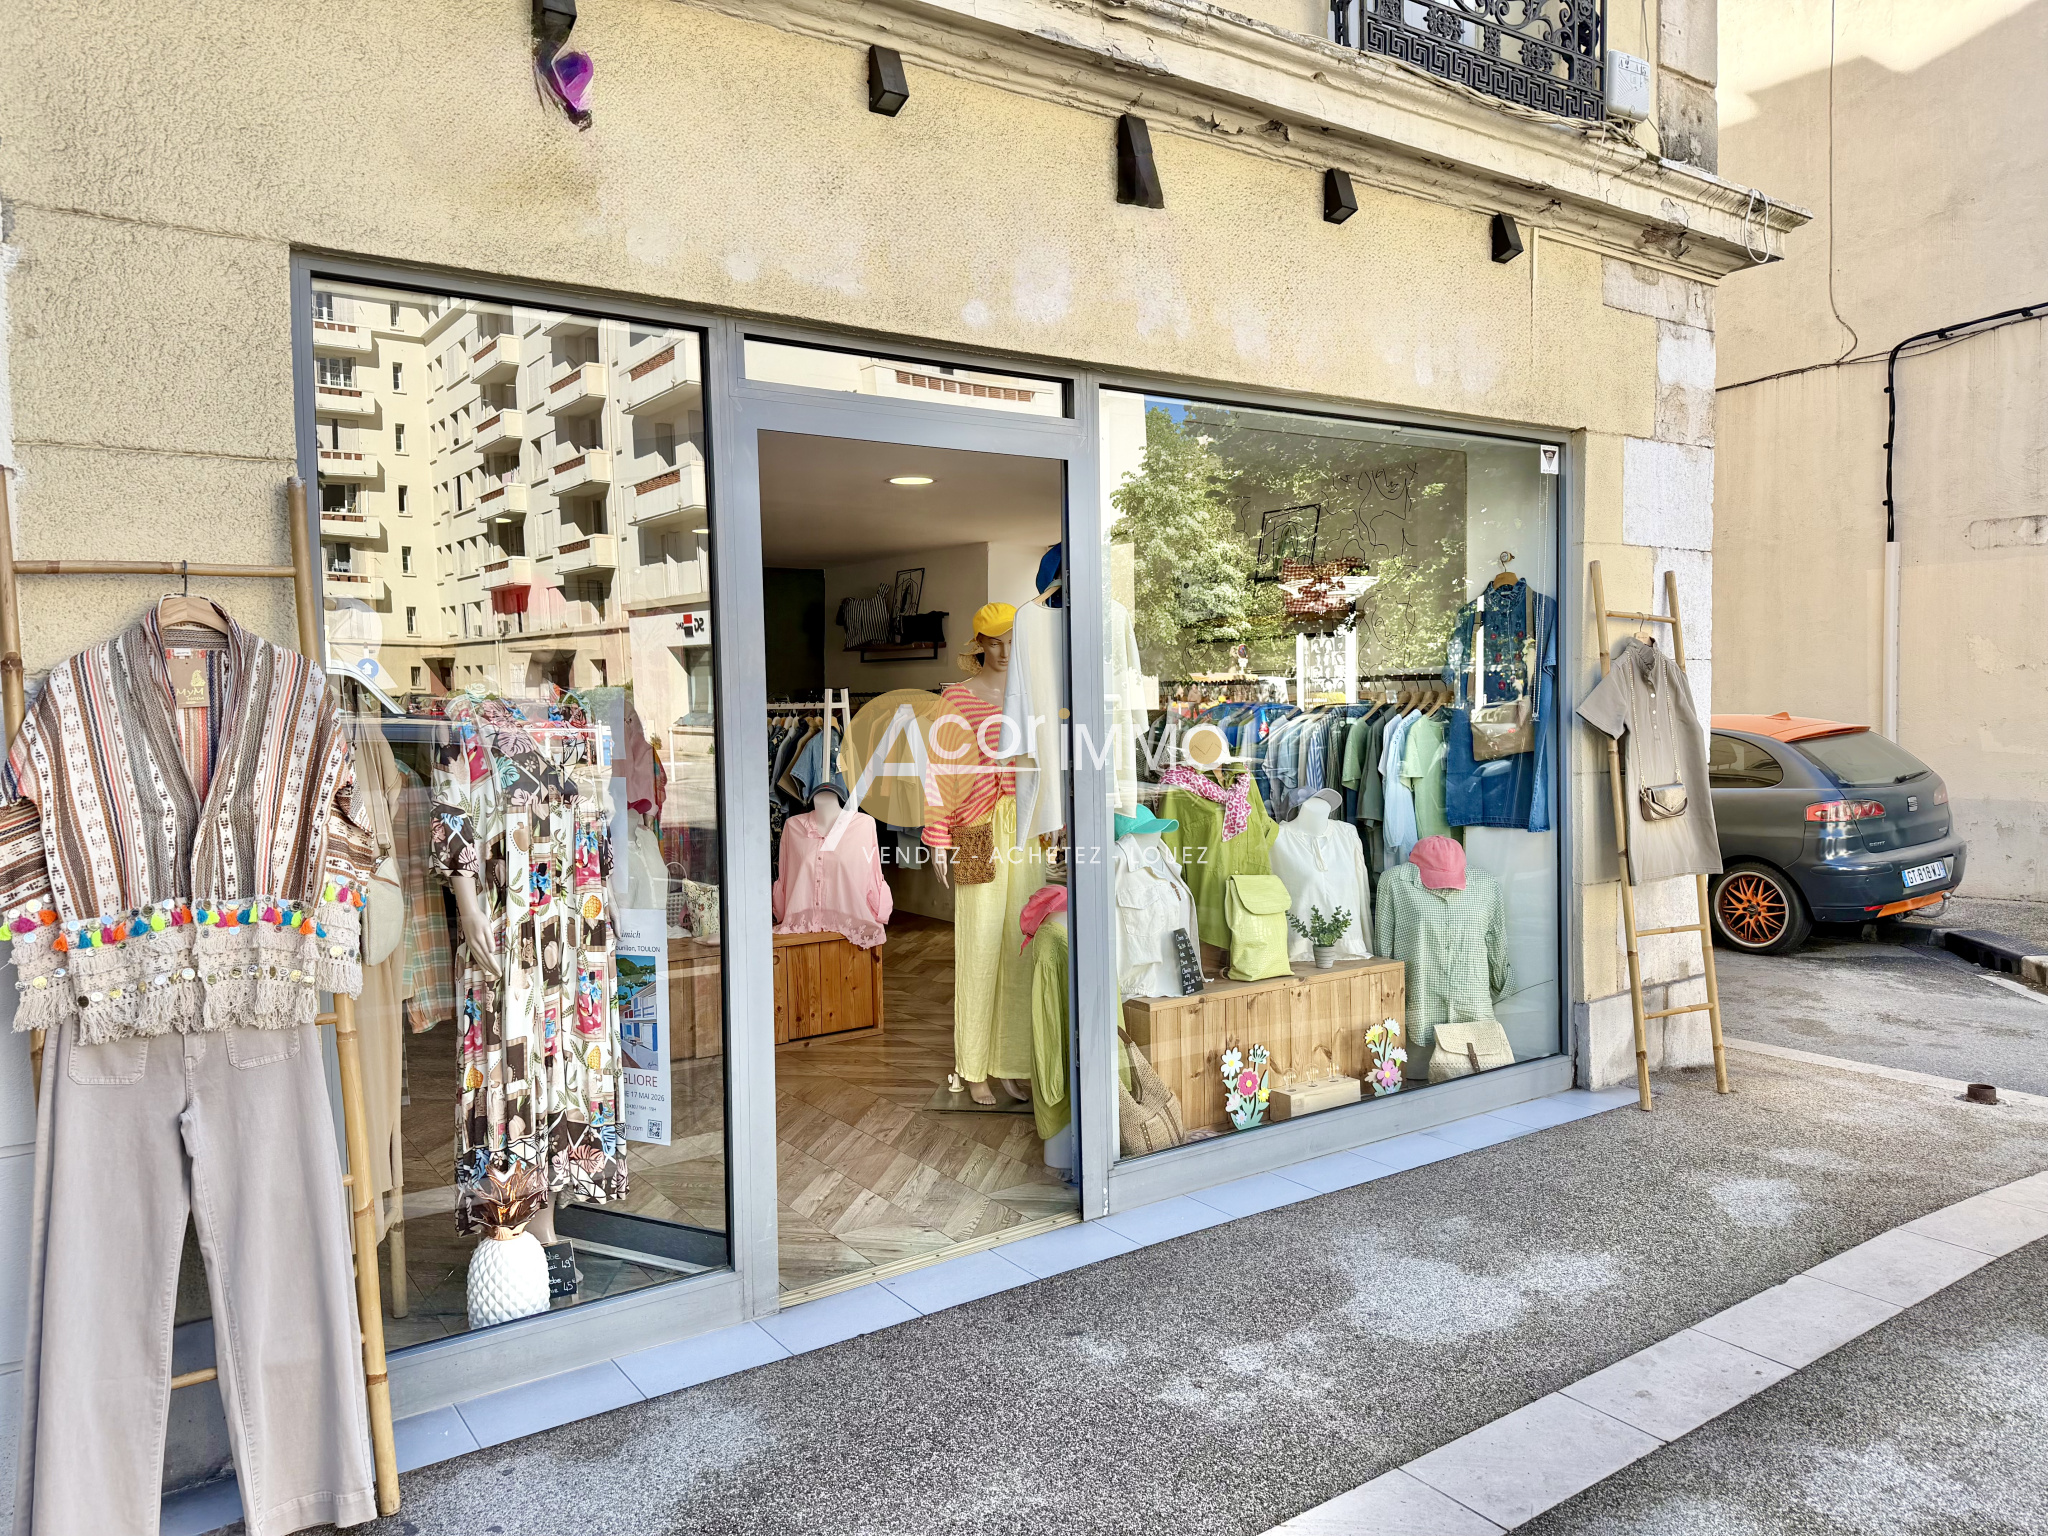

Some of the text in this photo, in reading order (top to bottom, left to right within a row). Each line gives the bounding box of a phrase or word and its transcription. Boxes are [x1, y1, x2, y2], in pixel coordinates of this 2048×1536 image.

[620, 930, 641, 939] imich
[638, 945, 661, 953] TOULON
[623, 1073, 658, 1088] GLIORE
